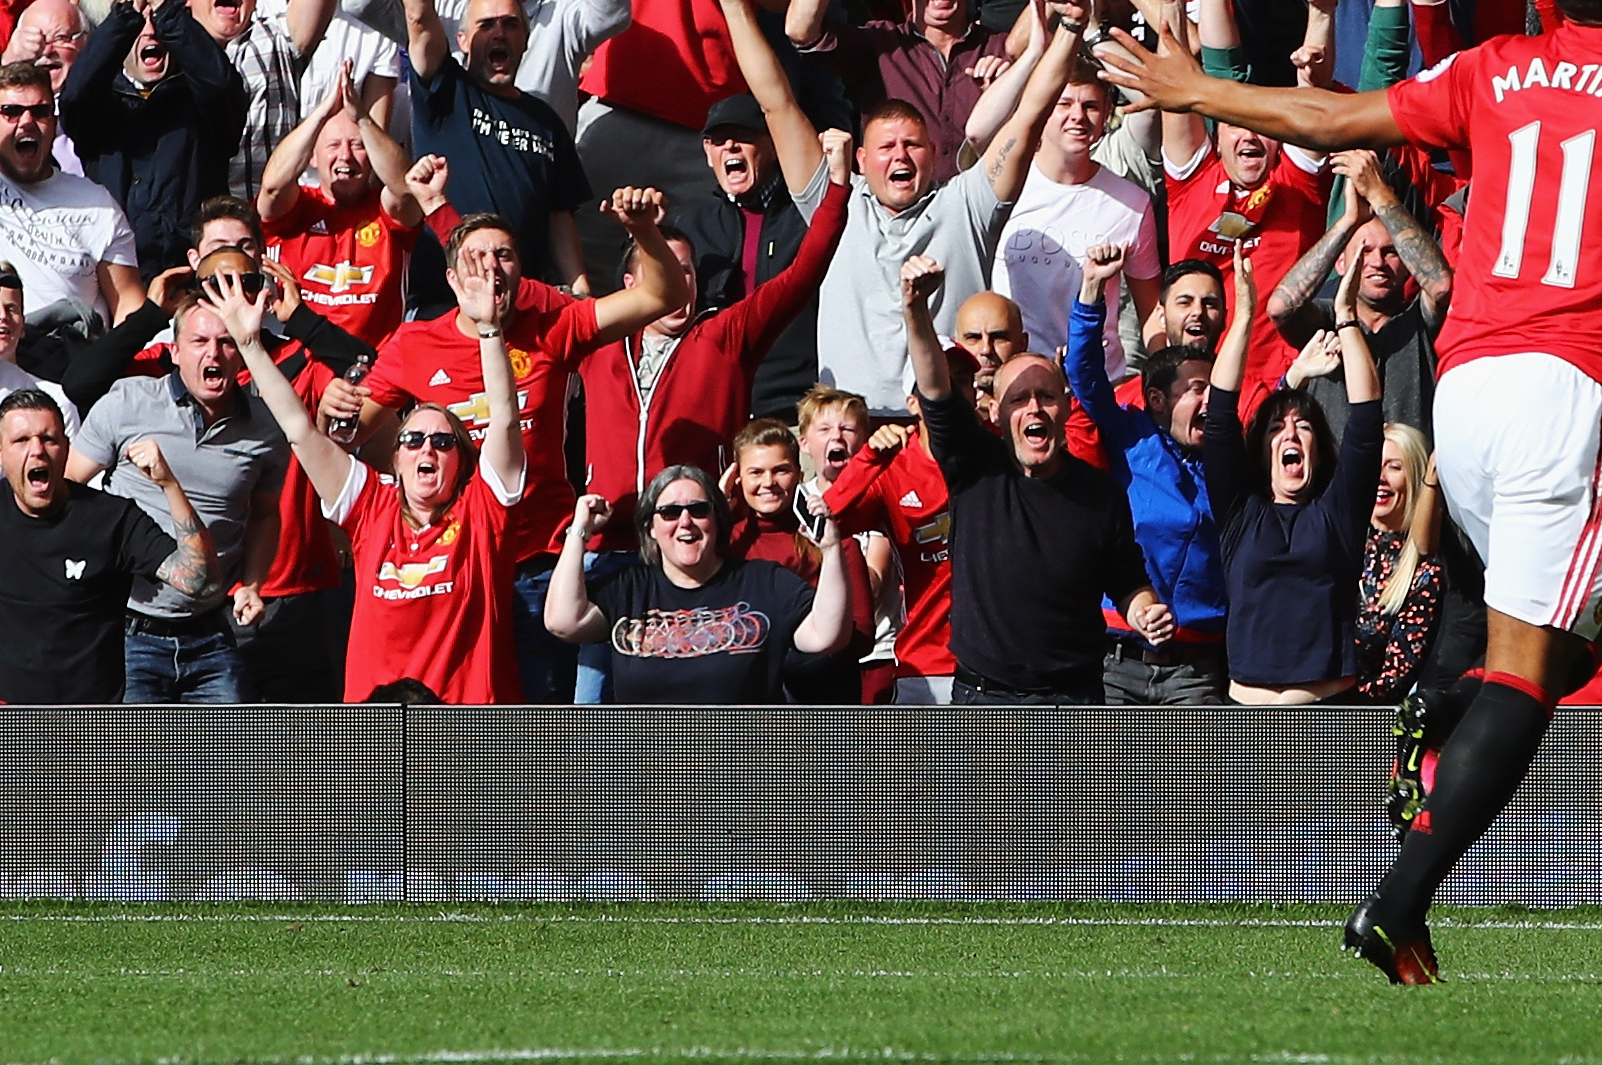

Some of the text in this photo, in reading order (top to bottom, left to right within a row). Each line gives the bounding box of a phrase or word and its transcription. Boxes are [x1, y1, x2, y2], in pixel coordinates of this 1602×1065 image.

[1492, 120, 1596, 289] 11
[300, 289, 379, 307] CHEVROLET
[373, 581, 455, 601] CHEVROLET
